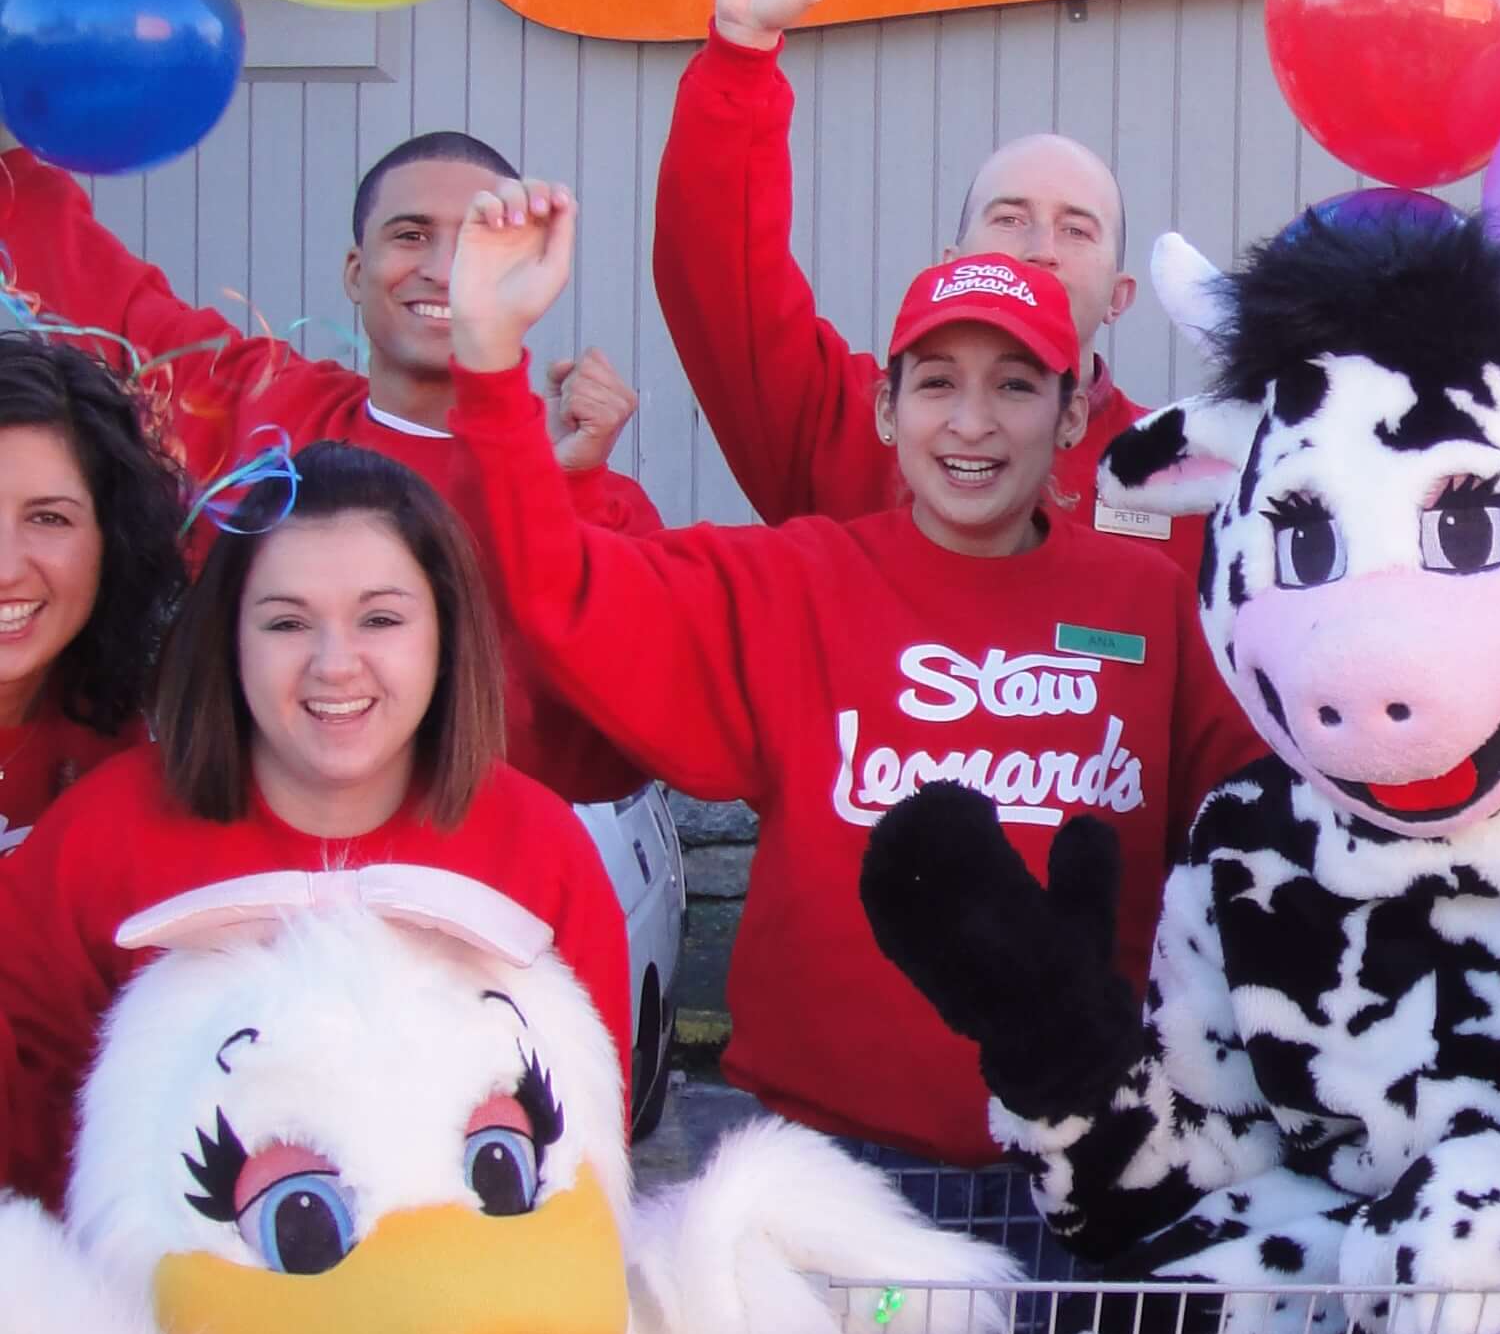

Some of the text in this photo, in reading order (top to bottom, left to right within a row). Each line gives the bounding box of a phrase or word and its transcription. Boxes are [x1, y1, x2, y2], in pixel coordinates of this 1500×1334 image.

[952, 265, 1017, 282] Stew
[931, 278, 1038, 306] Leonard's
[1114, 510, 1151, 524] PETER
[899, 644, 1101, 721] Stew
